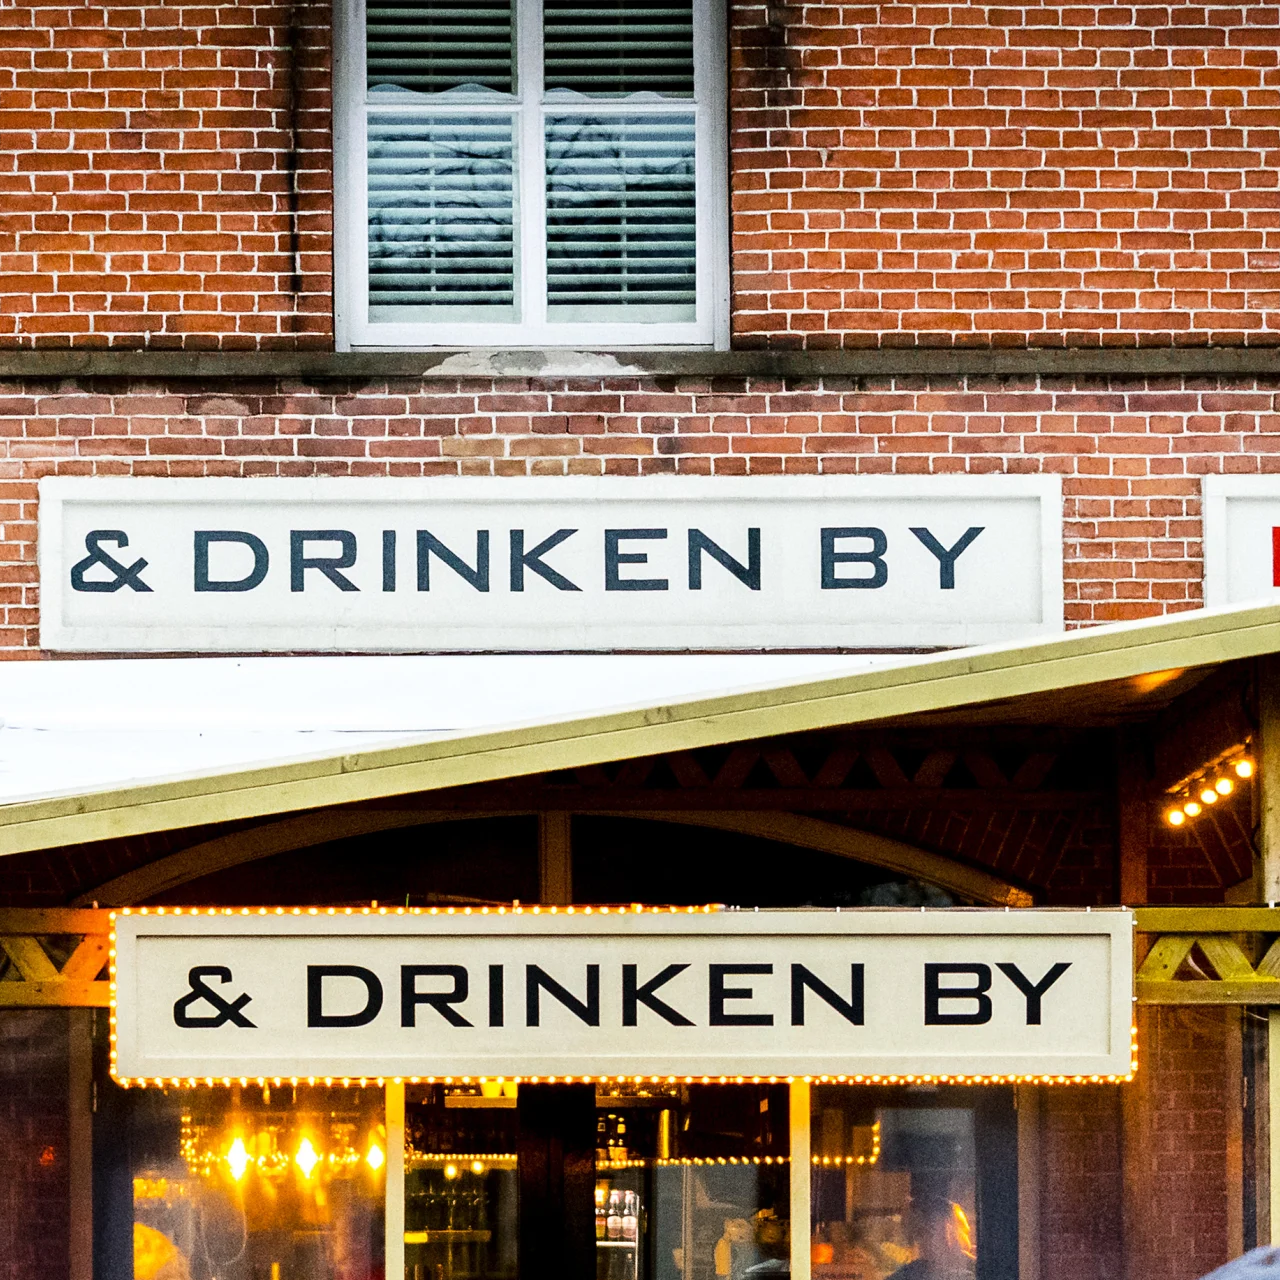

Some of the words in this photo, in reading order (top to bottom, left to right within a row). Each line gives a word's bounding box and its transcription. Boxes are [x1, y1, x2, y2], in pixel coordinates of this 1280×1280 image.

[70, 529, 153, 593] &
[193, 527, 763, 593] DRINKEN
[820, 526, 986, 591] BY
[173, 965, 257, 1029] &
[306, 963, 866, 1028] DRINKEN
[924, 962, 1073, 1026] BY
